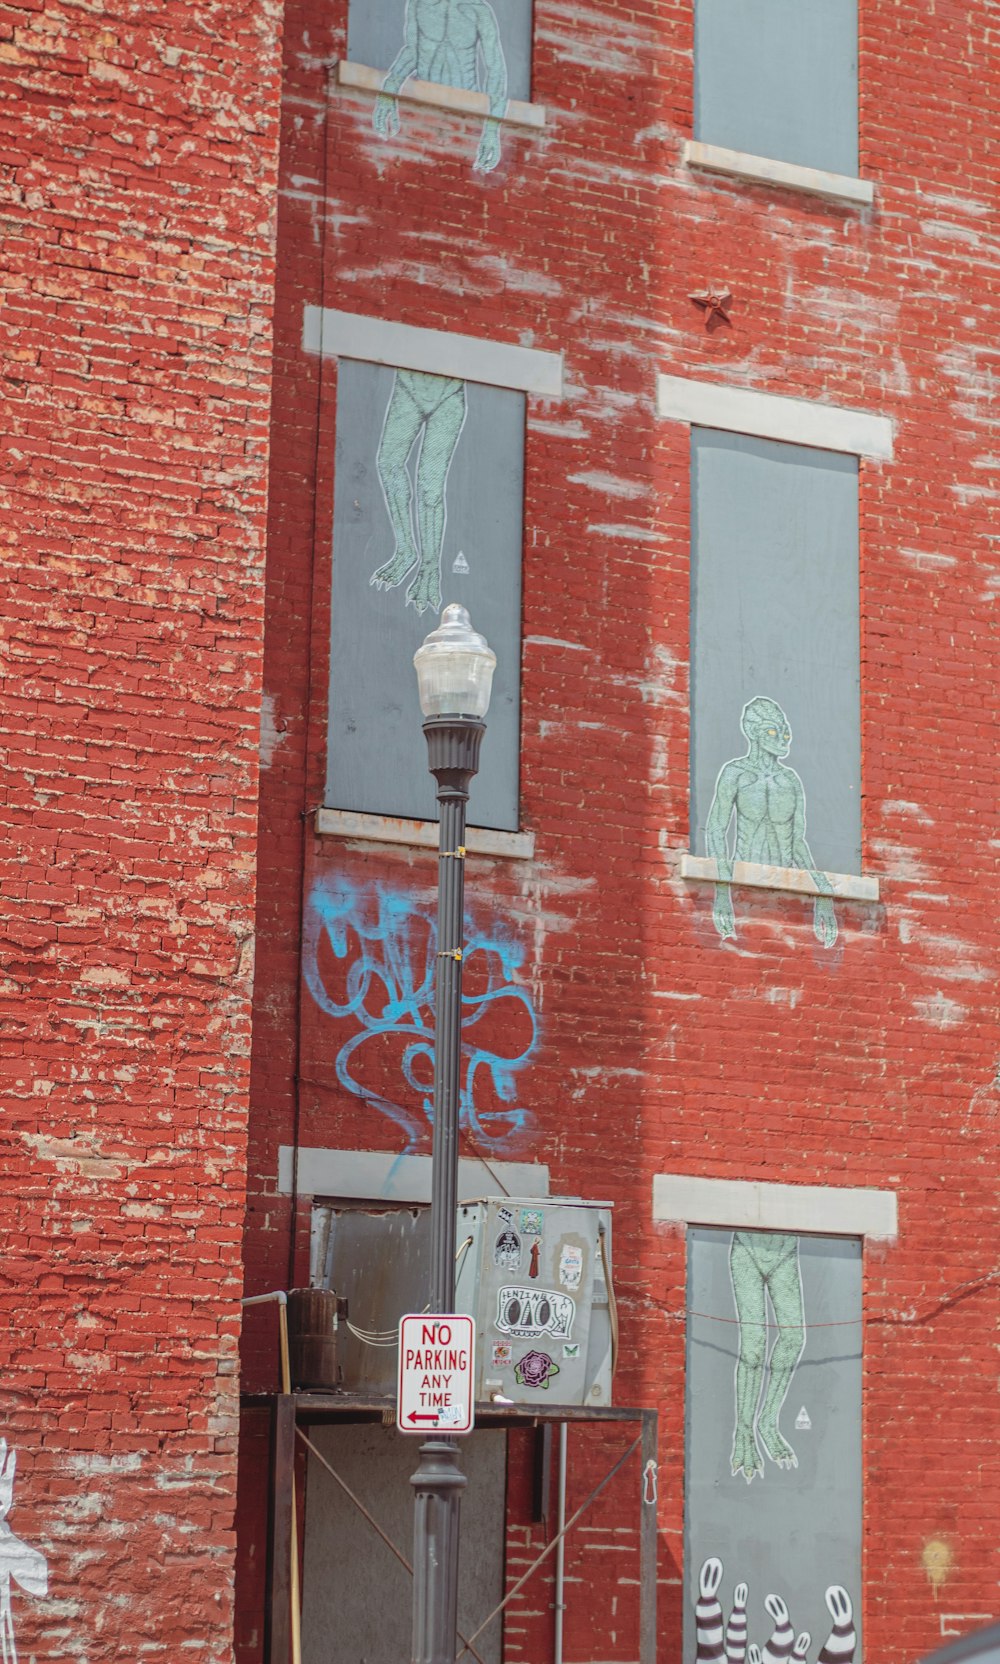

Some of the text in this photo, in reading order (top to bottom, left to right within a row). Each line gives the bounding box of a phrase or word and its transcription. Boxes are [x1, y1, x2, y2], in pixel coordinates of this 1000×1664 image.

[422, 1324, 452, 1345] NO
[406, 1349, 467, 1371] PARKING
[421, 1374, 452, 1389] ANY
[419, 1392, 452, 1407] TIME
